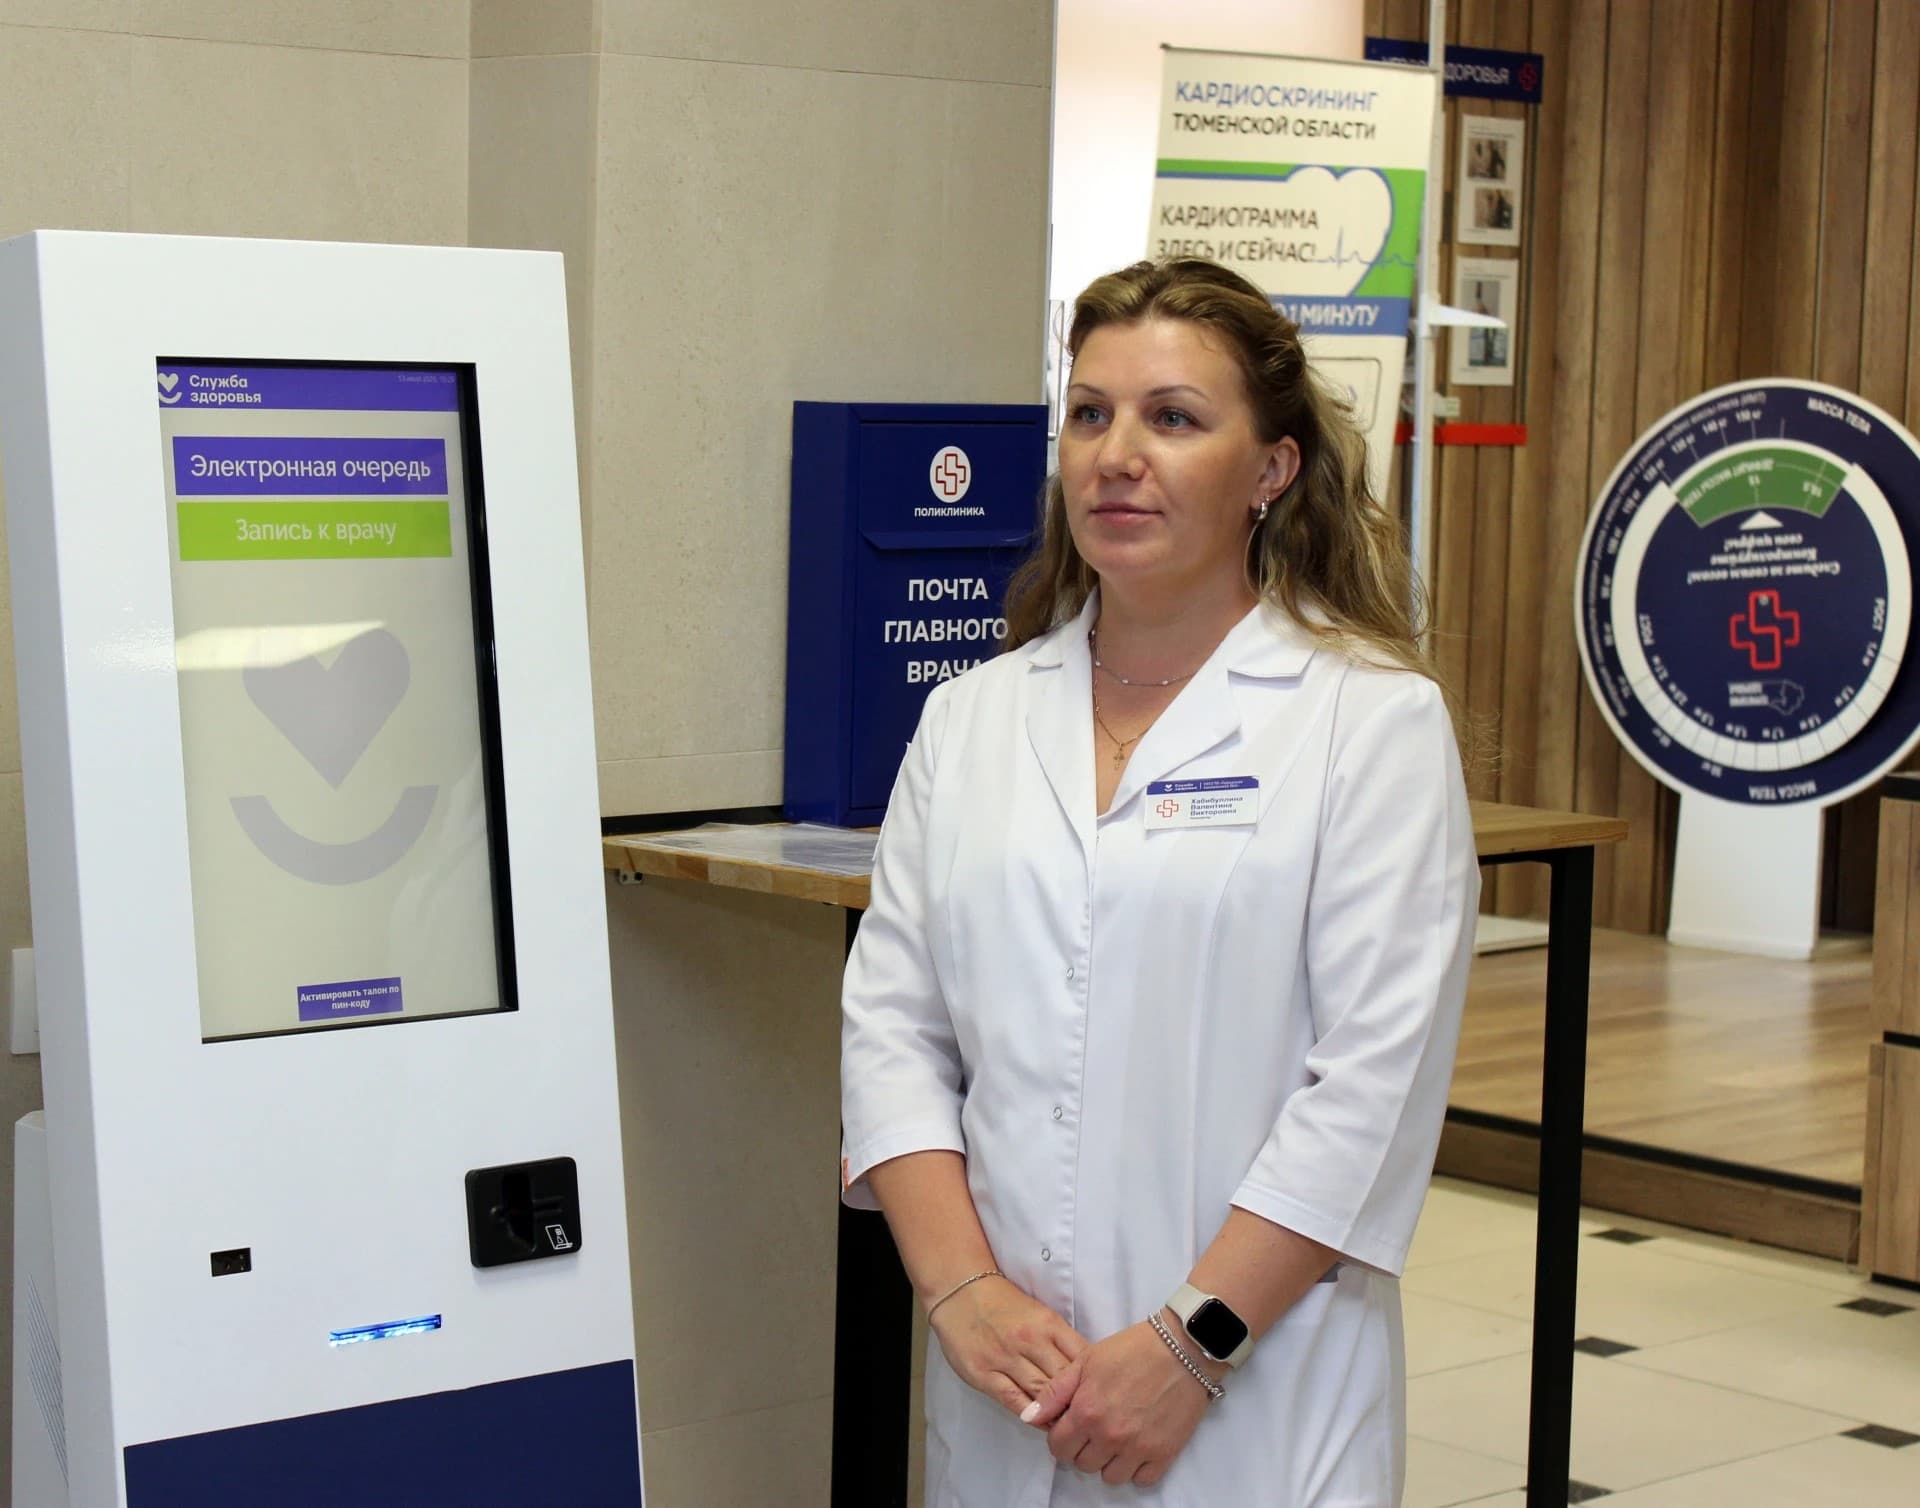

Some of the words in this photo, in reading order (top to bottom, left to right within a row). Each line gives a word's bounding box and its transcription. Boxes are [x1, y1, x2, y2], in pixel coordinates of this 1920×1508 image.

[1444, 61, 1510, 85] ДОРОВЬЯ
[1175, 81, 1378, 112] КАРДИОСКРИНИНГ
[1174, 112, 1288, 136] ТЮМЕНСКОЙ
[1292, 118, 1376, 140] ОБЛАСТИ
[1160, 204, 1319, 230] КАРДИОГРАММА
[1218, 240, 1234, 260] И
[1236, 237, 1316, 263] СЕЙЧАС!
[1301, 303, 1380, 327] МИНУТУ
[189, 374, 248, 391] Служба
[190, 390, 262, 405] здоровья
[1807, 397, 1844, 421] МАССА
[1845, 409, 1872, 436] ТЕЛА
[190, 454, 337, 483] Электронная
[342, 459, 431, 482] очередь
[914, 506, 985, 518] ПОЛИКЛИНИКА
[235, 518, 312, 542] Запись
[318, 523, 330, 541] к
[336, 522, 397, 545] врачу
[908, 577, 989, 602] ПОЧТА
[884, 617, 1008, 643] ГЛАВНОГО
[1748, 785, 1778, 800] ТЕЛА
[1778, 779, 1817, 799] МАССА
[300, 989, 362, 1002] Активировать
[363, 987, 388, 997] талон
[389, 985, 400, 994] по
[331, 999, 371, 1010] пин-коду
